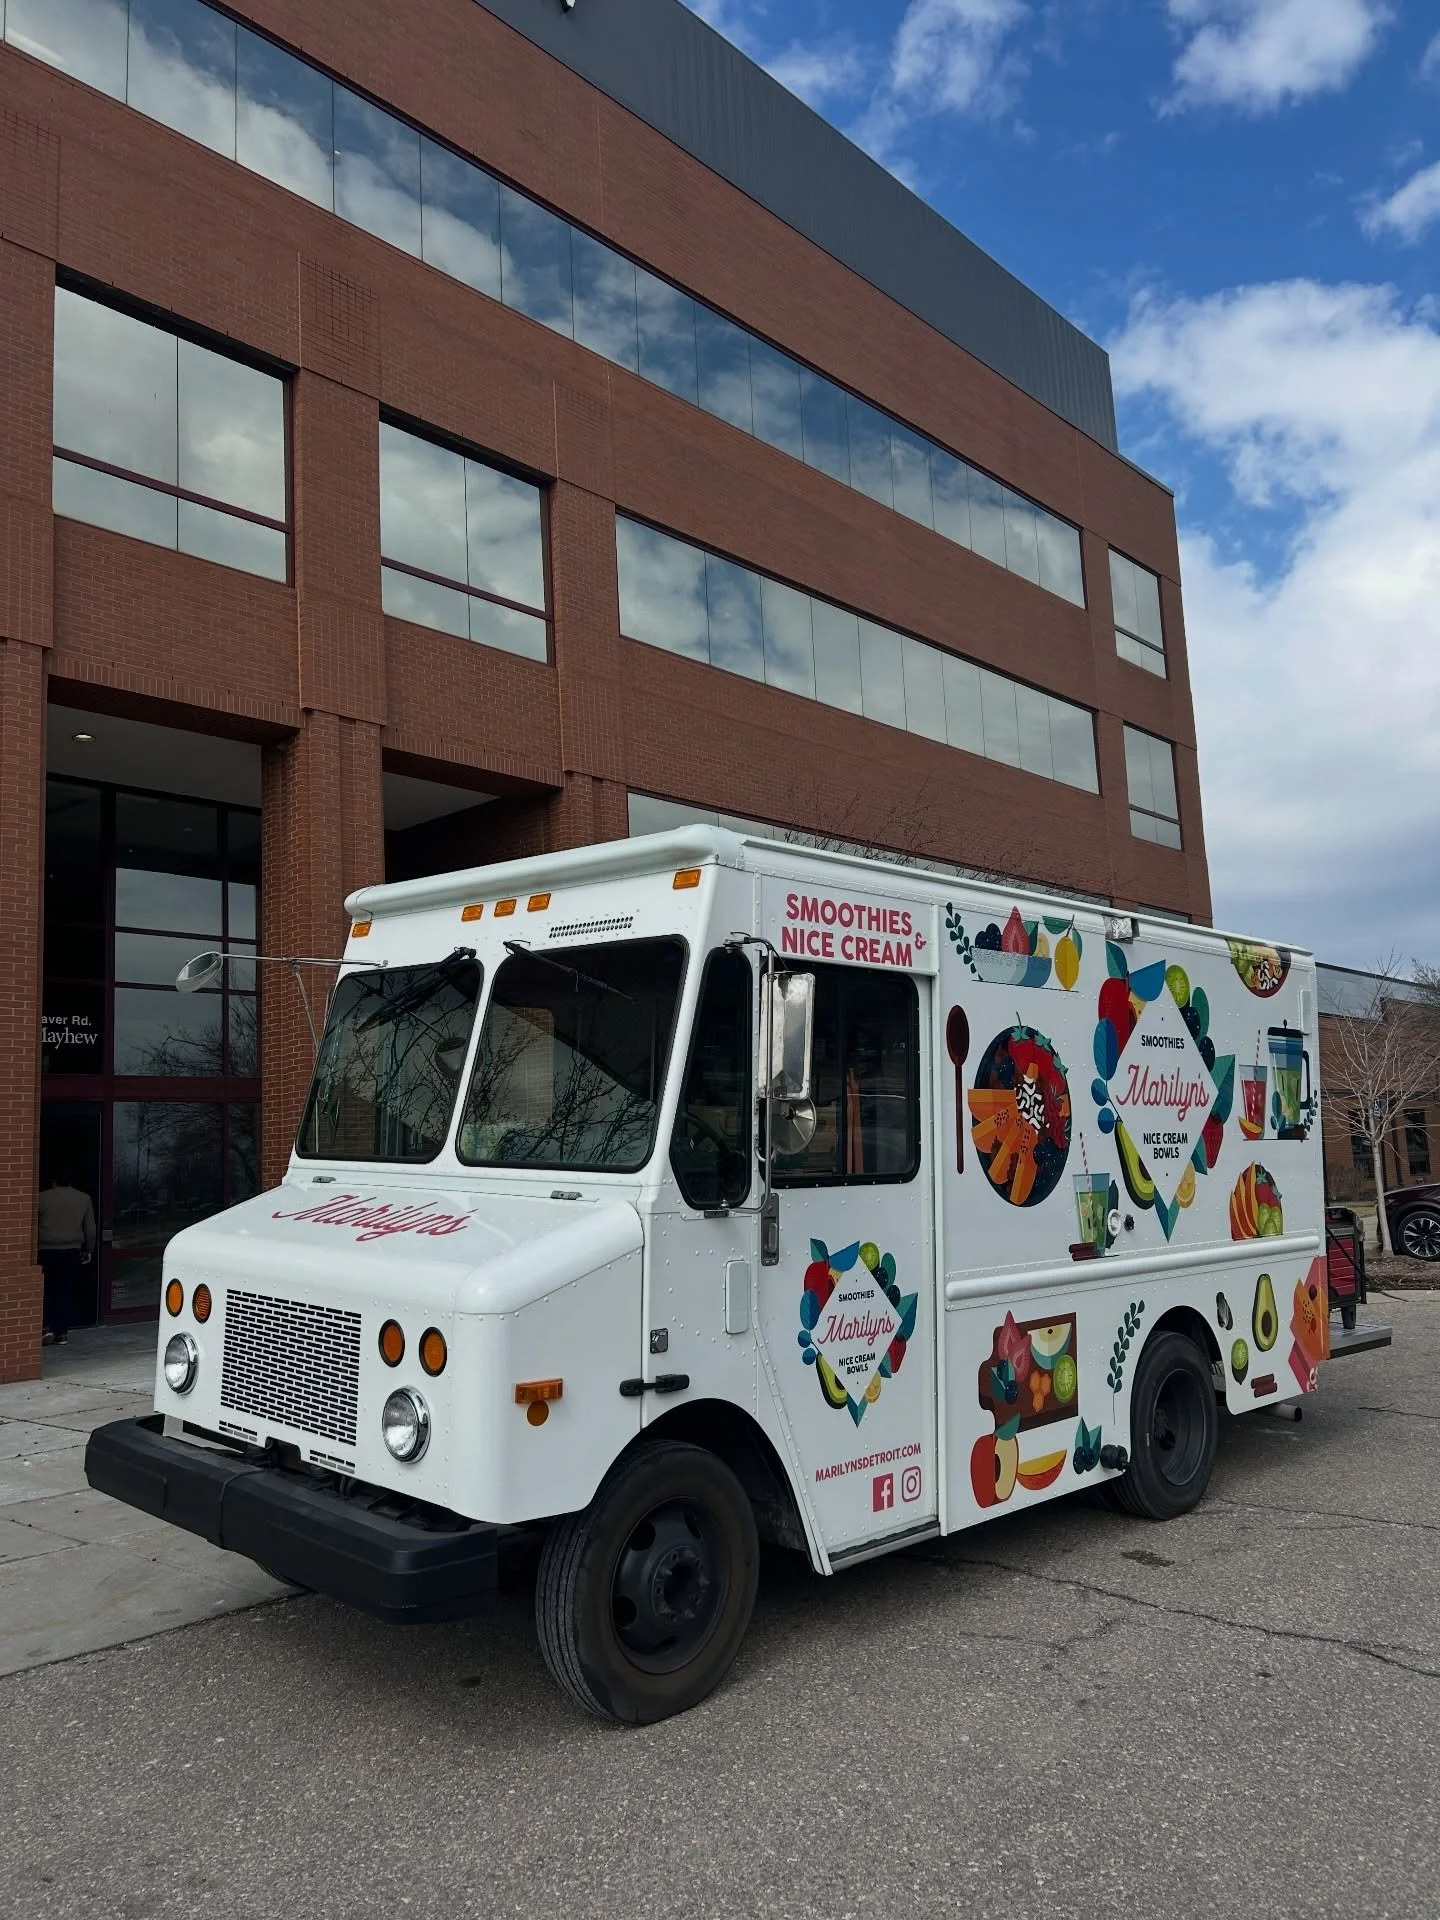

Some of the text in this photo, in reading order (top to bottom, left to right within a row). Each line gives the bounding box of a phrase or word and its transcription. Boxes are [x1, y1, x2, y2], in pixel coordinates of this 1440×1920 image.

[786, 893, 912, 936] SMOOTHIES
[781, 926, 927, 967] NICE CREAM &
[72, 1015, 92, 1026] Rd.
[1141, 1034, 1185, 1050] SMOOTHIES
[1116, 1064, 1210, 1122] Marilyn's
[1143, 1132, 1188, 1145] NICE CREAM
[1153, 1147, 1180, 1160] BOWLS
[839, 1290, 875, 1302] SMOOTHIES
[817, 1310, 895, 1346] Marilyn's
[838, 1352, 876, 1366] NICE CREAM
[847, 1363, 869, 1375] BOWLS
[815, 1442, 922, 1482] MARILYNSDETROIT.COM
